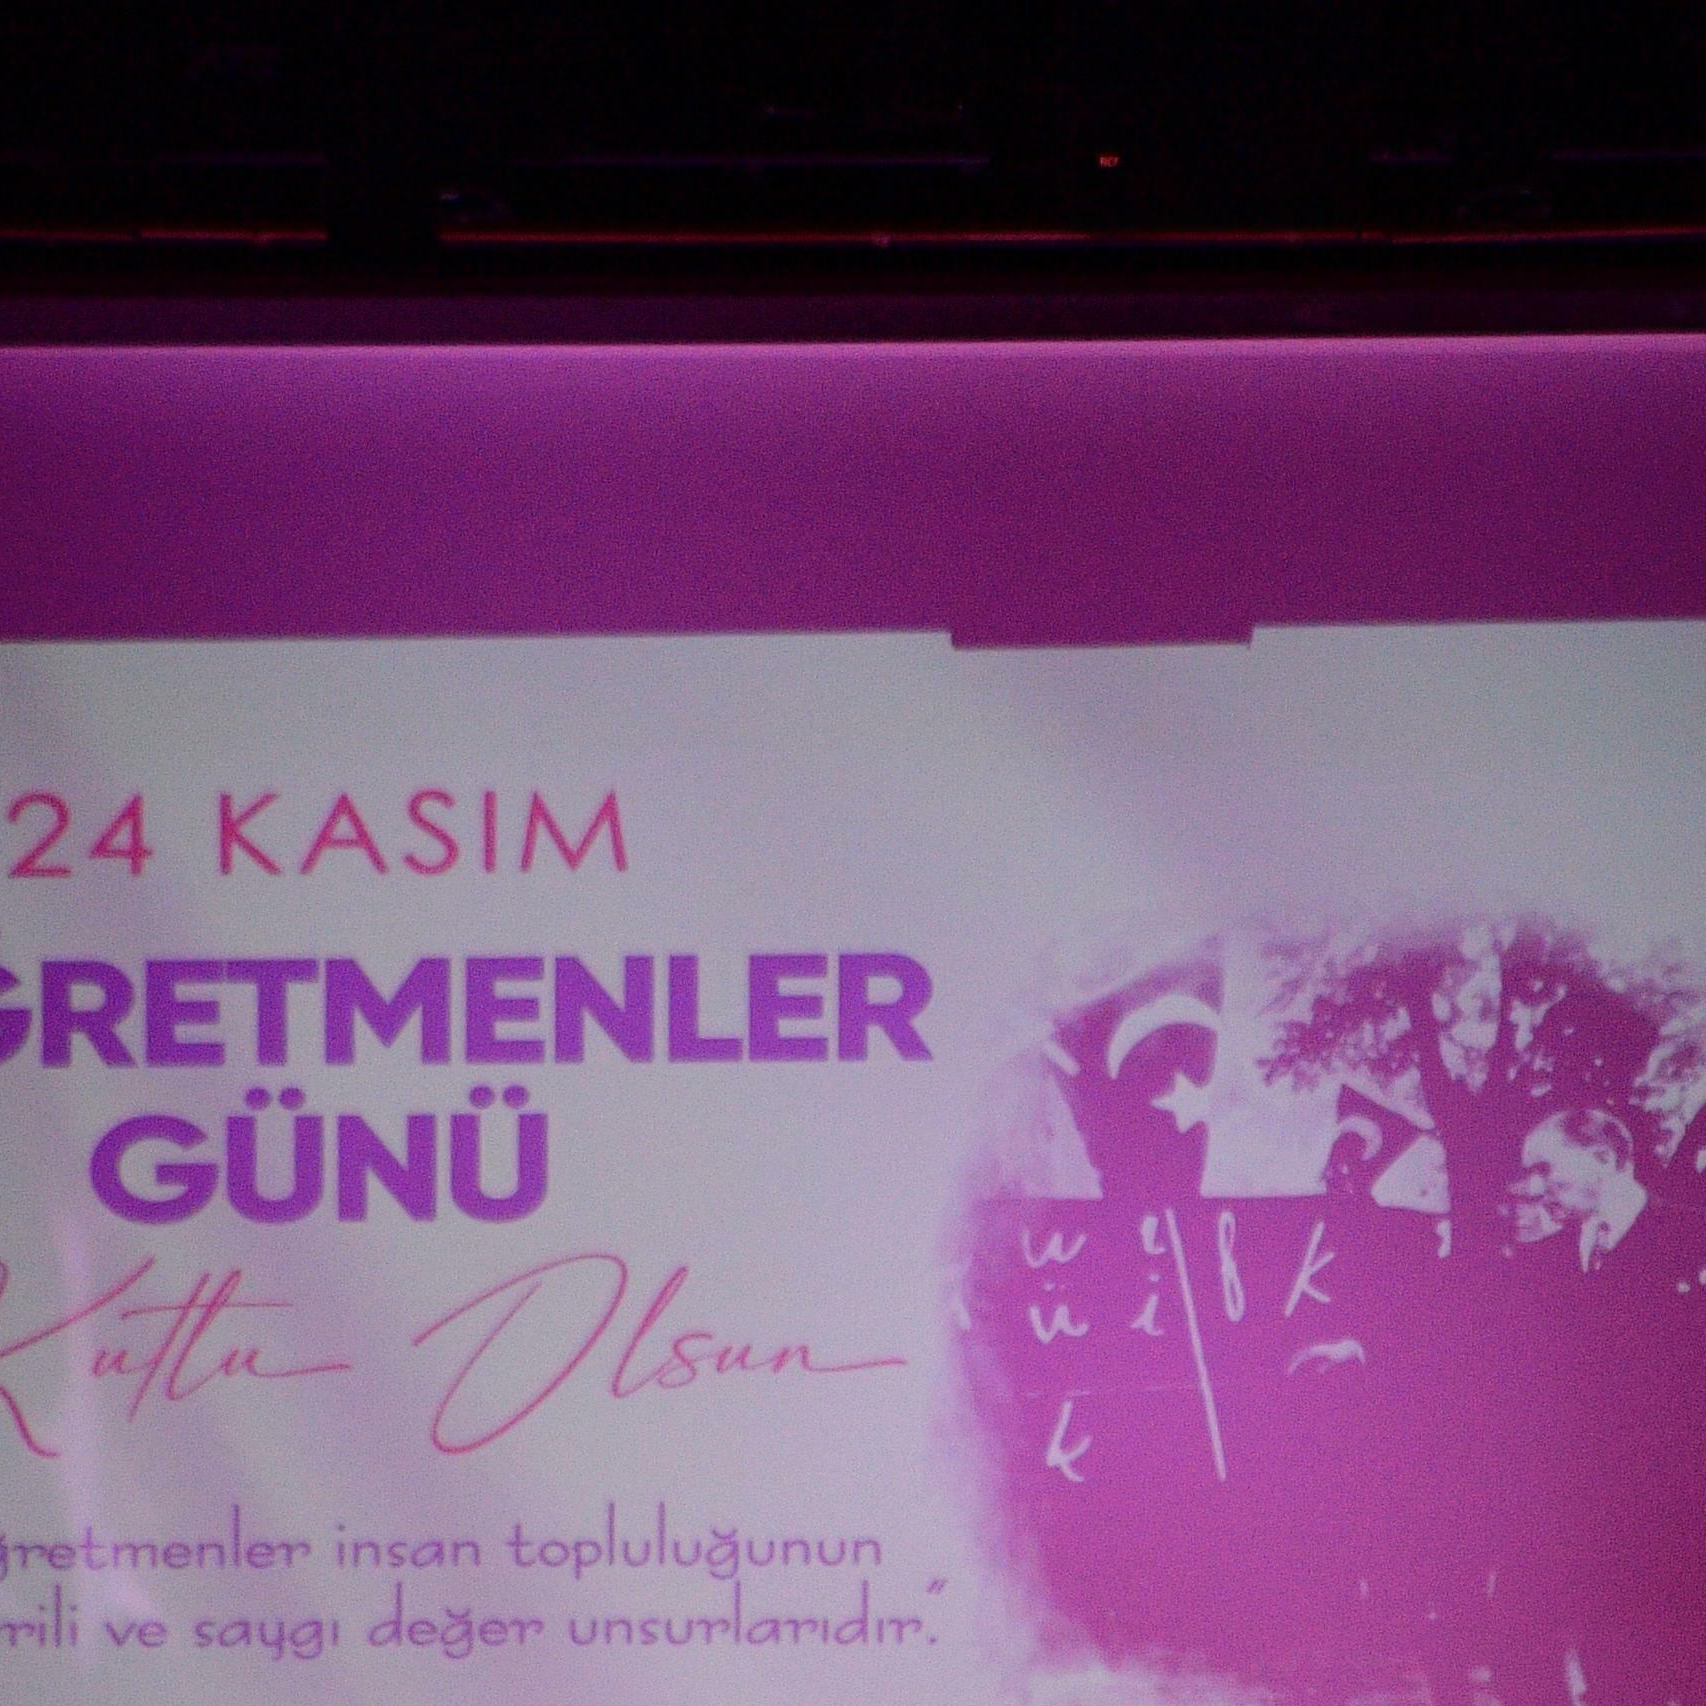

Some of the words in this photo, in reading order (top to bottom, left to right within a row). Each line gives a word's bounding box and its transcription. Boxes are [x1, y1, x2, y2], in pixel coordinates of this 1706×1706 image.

[6, 790, 154, 879] 24
[217, 787, 629, 876] KASIM
[89, 1085, 549, 1226] GÜNÜ
[412, 1252, 909, 1456] Olsun
[334, 1525, 482, 1570] insan
[505, 1500, 884, 1581] topluluğunun
[102, 1618, 169, 1650] ve
[192, 1616, 341, 1662] saygı
[366, 1581, 545, 1661] değer
